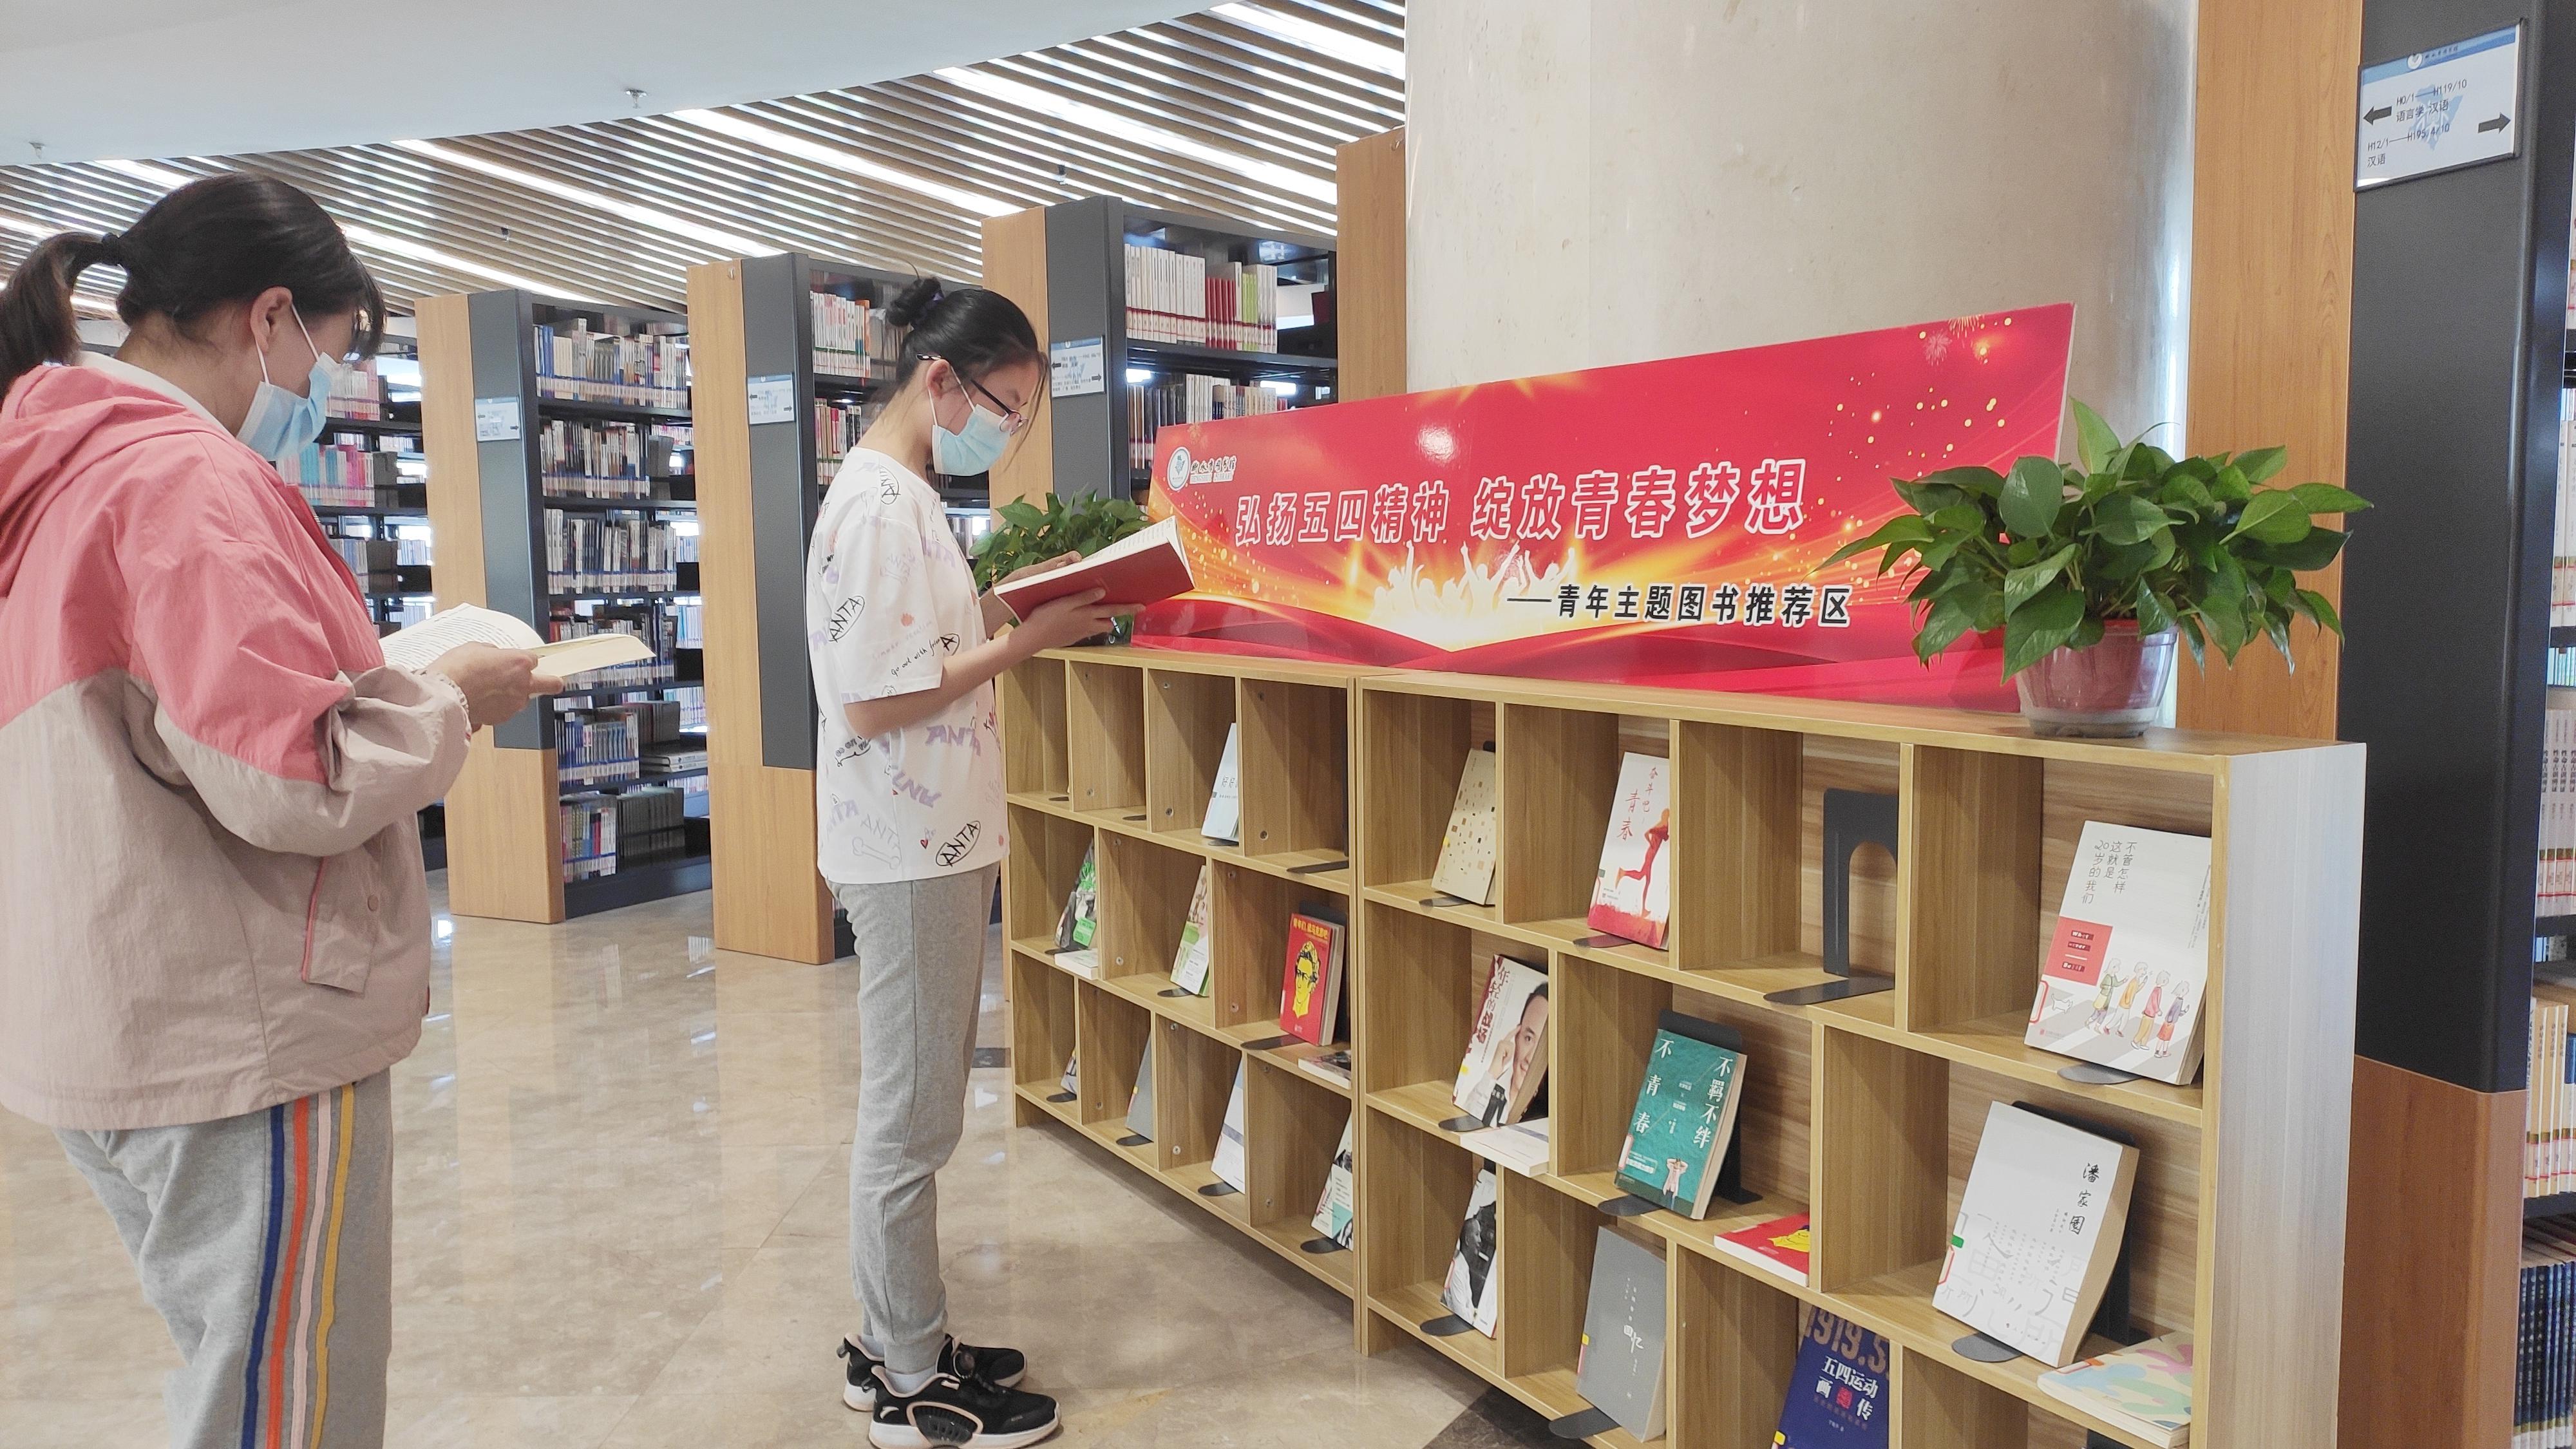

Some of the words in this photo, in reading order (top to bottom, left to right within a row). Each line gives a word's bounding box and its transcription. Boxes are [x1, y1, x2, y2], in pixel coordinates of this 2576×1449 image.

[2396, 104, 2424, 122] 语言学
[2429, 98, 2449, 115] 汉语
[2367, 153, 2386, 168] 汉语
[1235, 480, 1450, 547] 弘扬五四精神
[1470, 458, 1806, 542] 绽放青春梦想
[829, 597, 862, 643] ANTA
[940, 823, 979, 867] ANTA
[2103, 840, 2123, 880] 这就是
[2081, 840, 2110, 905] 20岁的我们
[1633, 1038, 1674, 1135] 不青春
[1692, 1056, 1734, 1149] 不羁不绊
[1821, 1356, 1879, 1399] 五四运动
